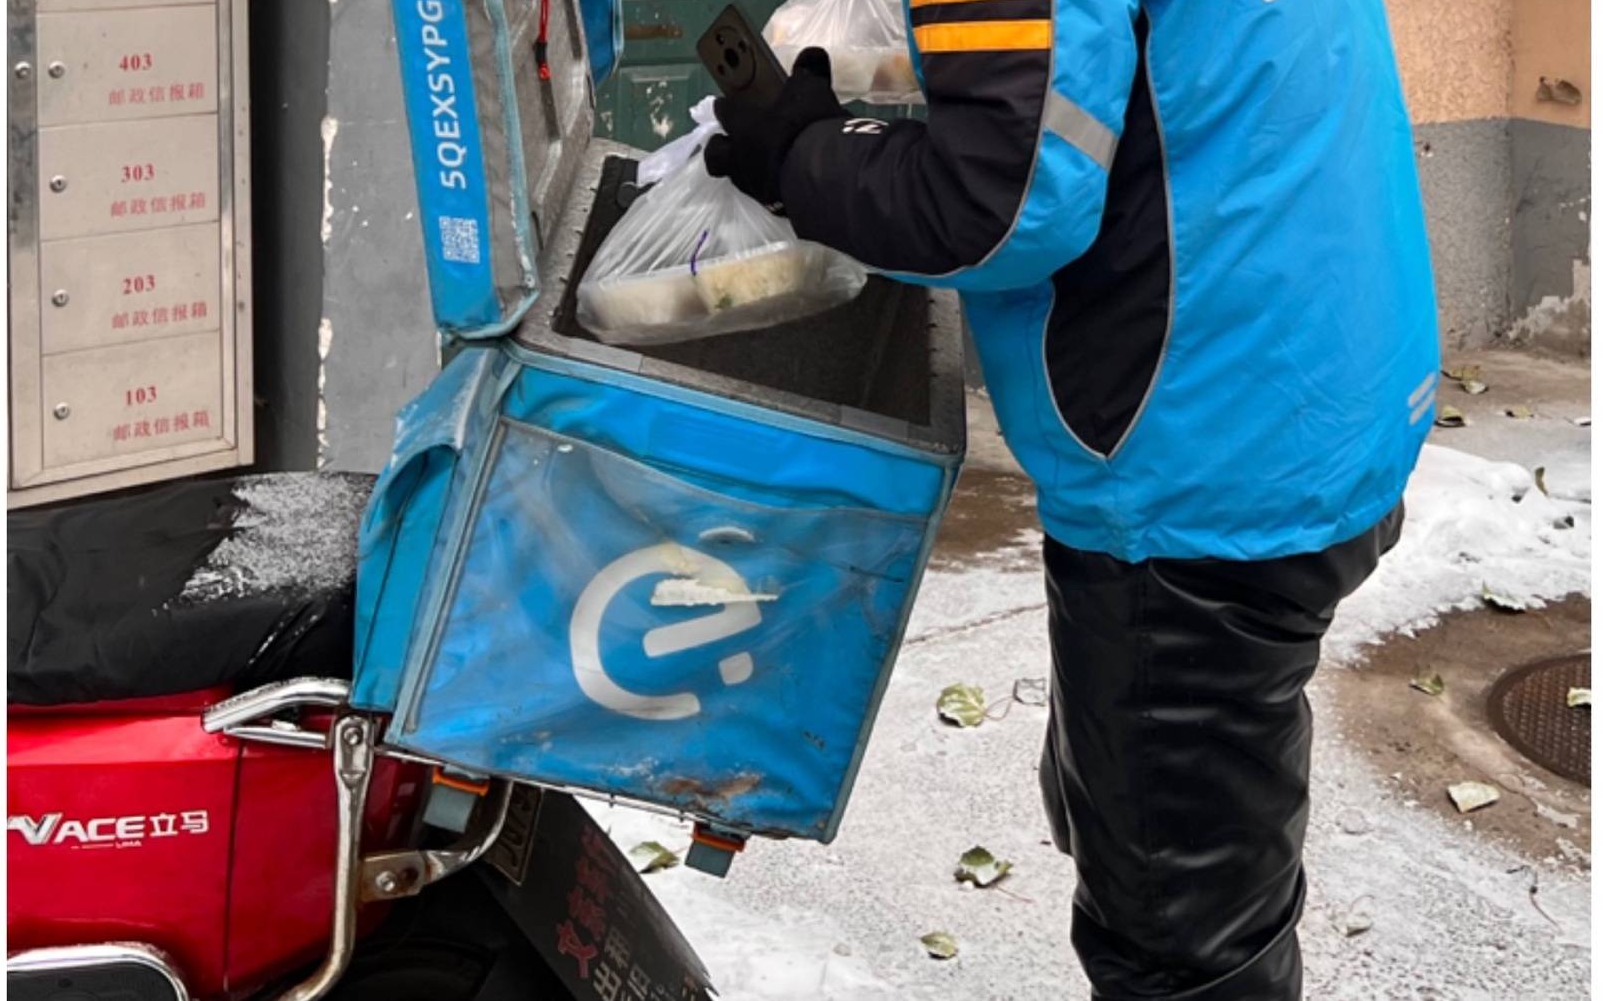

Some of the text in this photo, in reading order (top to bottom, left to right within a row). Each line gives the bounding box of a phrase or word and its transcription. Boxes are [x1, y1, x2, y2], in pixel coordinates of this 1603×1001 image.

[118, 54, 153, 72] 403
[108, 81, 206, 106] 邮政信报箱
[415, 0, 467, 190] 5QEXSYPG
[120, 164, 156, 184] 303
[110, 191, 207, 217] 邮政信报箱
[122, 275, 157, 295] 203
[111, 301, 208, 329] 邮政信报箱
[124, 385, 158, 406] 103
[112, 410, 210, 441] 邮政信报箱
[149, 809, 209, 837] 立马
